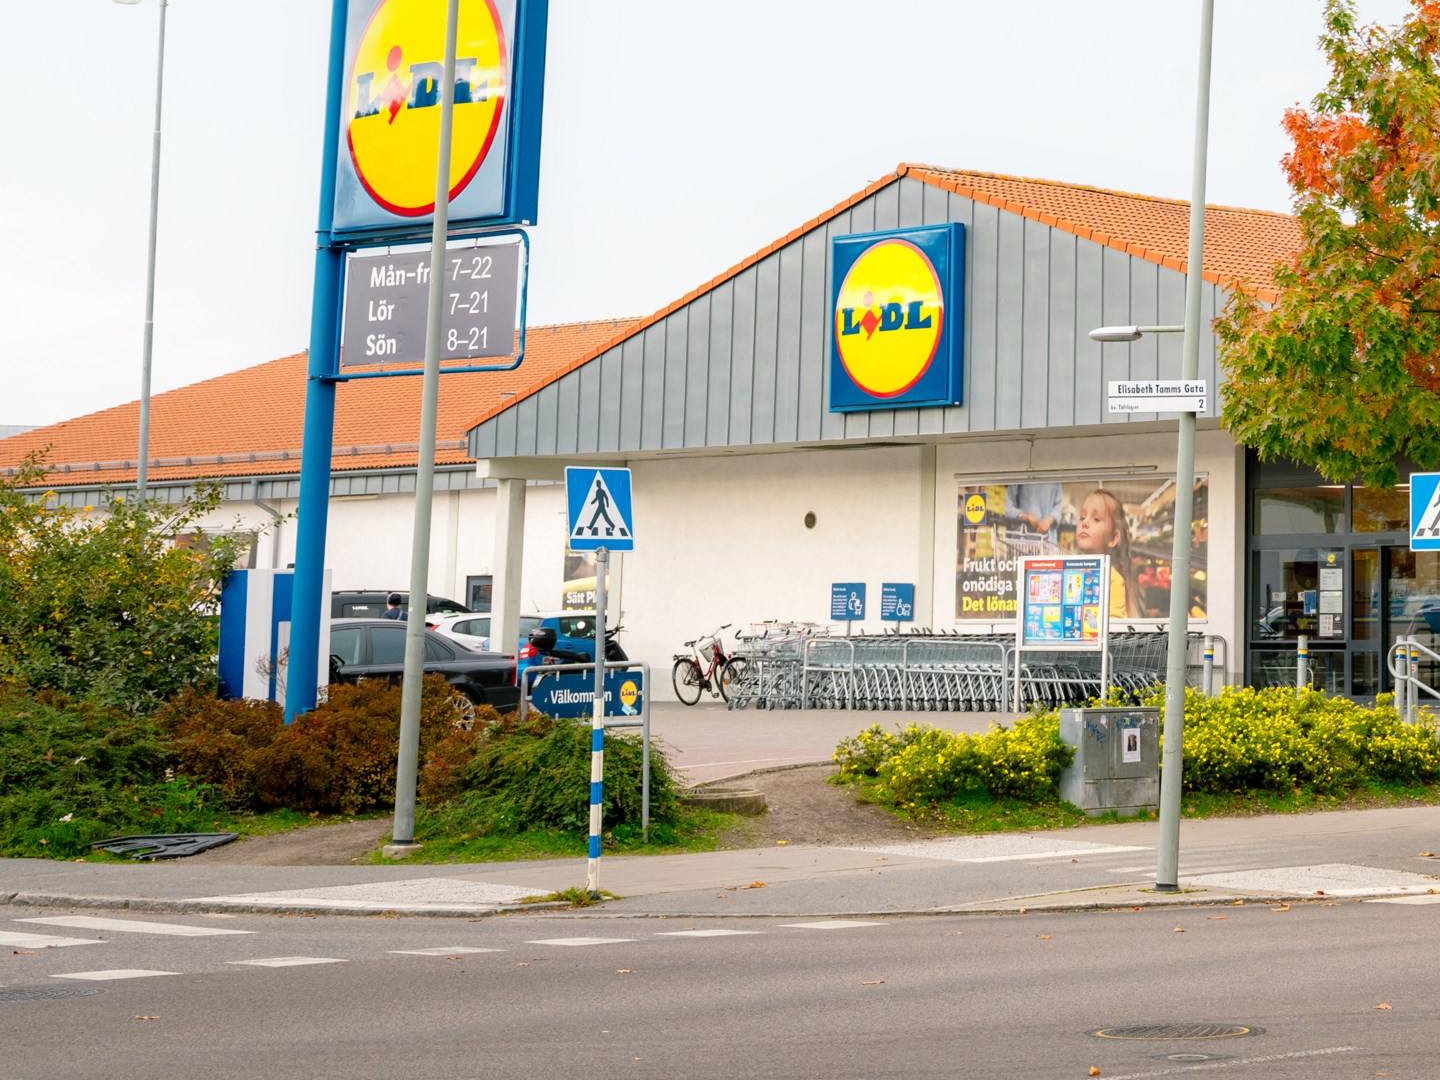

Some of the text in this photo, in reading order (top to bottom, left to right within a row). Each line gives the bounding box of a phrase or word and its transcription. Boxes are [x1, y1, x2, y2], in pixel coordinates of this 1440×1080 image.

[368, 300, 395, 321] Lör
[365, 333, 397, 356] Sön
[1117, 383, 1204, 394] Elisabeth Tamms Gata
[1198, 398, 1204, 409] 2
[963, 557, 996, 572] Frukt
[962, 576, 1013, 595] onödiga
[566, 591, 585, 604] Sätt
[962, 596, 984, 612] Det
[550, 688, 612, 704] Välkommn
